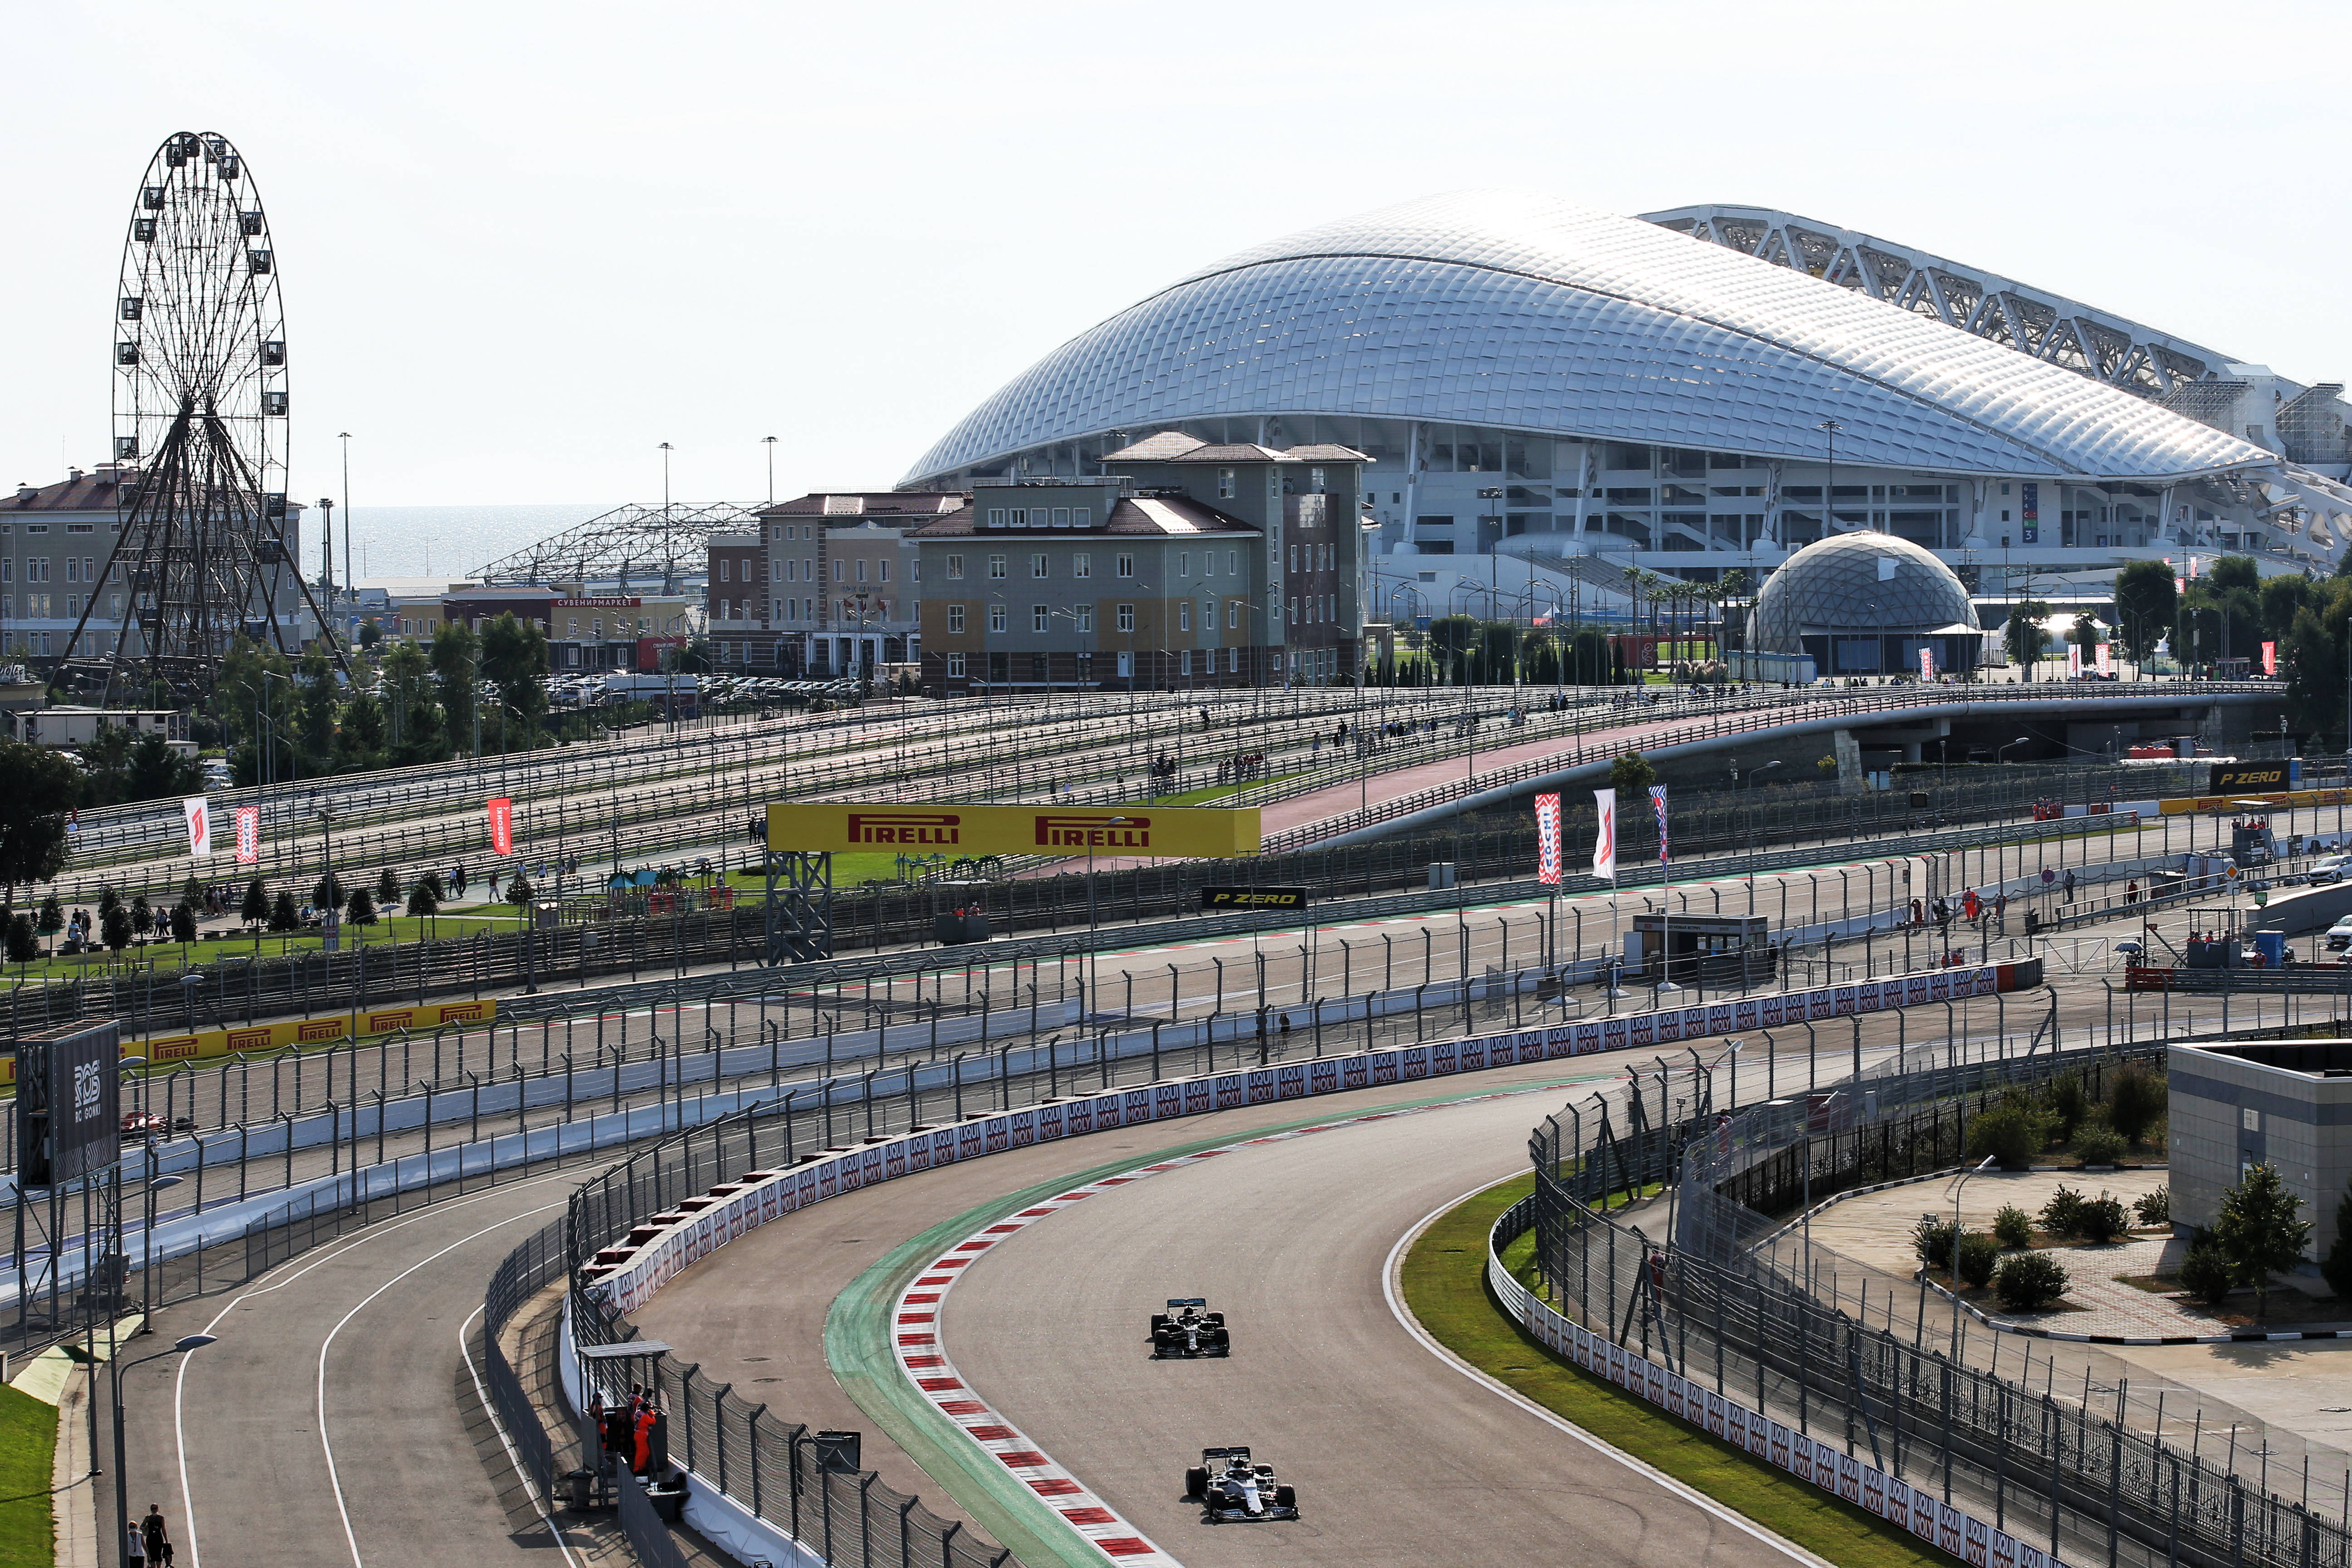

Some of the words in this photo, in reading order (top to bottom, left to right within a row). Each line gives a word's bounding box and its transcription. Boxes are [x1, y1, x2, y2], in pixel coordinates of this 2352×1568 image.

[2025, 530, 2032, 540] 3
[2220, 774, 2234, 785] P
[2235, 771, 2281, 784] ZERO
[848, 813, 960, 843] PIRELLI
[1035, 816, 1151, 847] PIRELLI
[1214, 894, 1230, 902] P
[1234, 894, 1296, 904] ZERO
[1909, 978, 1925, 990] LIQUI
[1931, 975, 1948, 987] LIQUI
[1836, 988, 1853, 1000] LIQUI
[1909, 989, 1926, 1001] MOLY
[1932, 986, 1949, 998] MOLY
[1737, 1002, 1754, 1015] LIQUI
[1787, 995, 1803, 1008] LIQUI
[1837, 1000, 1855, 1013] MOLY
[370, 1011, 413, 1032] PIRELLI
[440, 1004, 482, 1024] PIRELLI
[1660, 1013, 1677, 1026] LIQUI
[1686, 1009, 1704, 1022] LIQUI
[1738, 1014, 1756, 1028] MOLY
[1787, 1007, 1805, 1020] MOLY
[298, 1020, 342, 1041] PIRELLI
[1578, 1024, 1597, 1038] LIQUI
[1606, 1020, 1624, 1034] LIQUI
[1632, 1016, 1651, 1030] LIQUI
[1687, 1022, 1705, 1035] MOLY
[227, 1029, 271, 1050] PIRELLI
[1520, 1032, 1540, 1046] LIQUI
[1549, 1028, 1569, 1042] LIQUI
[1607, 1033, 1626, 1047] MOLY
[1633, 1029, 1652, 1043] MOLY
[1661, 1025, 1679, 1039] MOLY
[154, 1038, 198, 1060] PIRELLI
[1434, 1044, 1454, 1058] LIQUI
[1462, 1040, 1482, 1054] LIQUI
[1491, 1036, 1511, 1050] LIQUI
[1550, 1041, 1570, 1055] MOLY
[1578, 1037, 1599, 1051] MOLY
[1374, 1053, 1395, 1068] LIQUI
[1405, 1049, 1425, 1063] LIQUI
[1492, 1049, 1512, 1063] MOLY
[1521, 1045, 1541, 1059] MOLY
[1312, 1061, 1335, 1077] LIQUI
[1344, 1057, 1365, 1072] LIQUI
[1406, 1062, 1426, 1077] MOLY
[1435, 1058, 1455, 1072] MOLY
[1463, 1054, 1484, 1068] MOLY
[1249, 1071, 1272, 1087] LIQUI
[1279, 1066, 1302, 1082] LIQUI
[1345, 1071, 1366, 1086] MOLY
[1375, 1067, 1396, 1081] MOLY
[1186, 1081, 1208, 1097] LIQUI
[1217, 1076, 1240, 1092] LIQUI
[1280, 1080, 1303, 1096] MOLY
[1313, 1075, 1336, 1091] MOLY
[1127, 1091, 1147, 1107] LIQUI
[1157, 1086, 1178, 1102] LIQUI
[1219, 1090, 1240, 1106] MOLY
[1250, 1085, 1273, 1101] MOLY
[1069, 1102, 1090, 1118] LIQUI
[1098, 1097, 1117, 1113] LIQUI
[1158, 1101, 1179, 1117] MOLY
[1187, 1096, 1209, 1112] MOLY
[75, 1103, 100, 1123] ROGONKI
[1013, 1113, 1032, 1130] LIQUI
[1040, 1107, 1060, 1124] LIQUI
[1098, 1112, 1119, 1128] MOLY
[1127, 1106, 1148, 1122] MOLY
[960, 1124, 979, 1142] LIQUI
[987, 1118, 1005, 1136] LIQUI
[1041, 1122, 1062, 1139] MOLY
[1070, 1117, 1091, 1133] MOLY
[911, 1136, 927, 1154] LIQUI
[935, 1130, 952, 1148] LIQUI
[988, 1134, 1007, 1151] MOLY
[1014, 1128, 1033, 1145] MOLY
[887, 1142, 903, 1160] LIQUI
[936, 1146, 954, 1164] MOLY
[961, 1140, 980, 1157] MOLY
[863, 1148, 880, 1167] LIQUI
[911, 1152, 929, 1170] MOLY
[864, 1165, 881, 1183] MOLY
[887, 1158, 904, 1176] MOLY
[1577, 1327, 1588, 1349] LIQUI
[1593, 1336, 1605, 1358] LIQUI
[1577, 1346, 1588, 1367] MOLY
[1611, 1345, 1623, 1368] LIQUI
[1593, 1355, 1605, 1377] MOLY
[1629, 1355, 1643, 1378] LIQUI
[1611, 1365, 1623, 1387] MOLY
[1649, 1364, 1663, 1388] LIQUI
[1629, 1374, 1643, 1396] MOLY
[1669, 1374, 1682, 1397] LIQUI
[1648, 1384, 1663, 1406] MOLY
[1688, 1383, 1702, 1406] LIQUI
[1669, 1394, 1682, 1416] MOLY
[1708, 1393, 1723, 1417] LIQUI
[1688, 1404, 1702, 1426] MOLY
[1729, 1403, 1744, 1427] LIQUI
[1708, 1413, 1723, 1436] MOLY
[1750, 1413, 1765, 1437] LIQUI
[1729, 1424, 1744, 1446] MOLY
[1772, 1423, 1788, 1448] LIQUI
[1750, 1434, 1765, 1457] MOLY
[1795, 1434, 1810, 1458] LIQUI
[1771, 1444, 1788, 1468] MOLY
[1817, 1444, 1833, 1470] LIQUI
[1794, 1455, 1810, 1479] MOLY
[1841, 1455, 1857, 1481] LIQUI
[1817, 1466, 1833, 1490] MOLY
[1865, 1467, 1882, 1493] LIQUI
[1841, 1477, 1857, 1502] MOLY
[1889, 1478, 1907, 1505] LIQUI
[1864, 1489, 1882, 1514] MOLY
[1915, 1490, 1932, 1518] LIQUI
[1889, 1500, 1907, 1526] MOLY
[1940, 1503, 1959, 1531] LIQUI
[1914, 1513, 1932, 1539] MOLY
[1966, 1517, 1986, 1545] LIQUI
[1940, 1526, 1959, 1553] MOLY
[1994, 1531, 2014, 1558] LIQUI
[1966, 1540, 1986, 1568] MOLY
[2022, 1546, 2041, 1568] LIQUI
